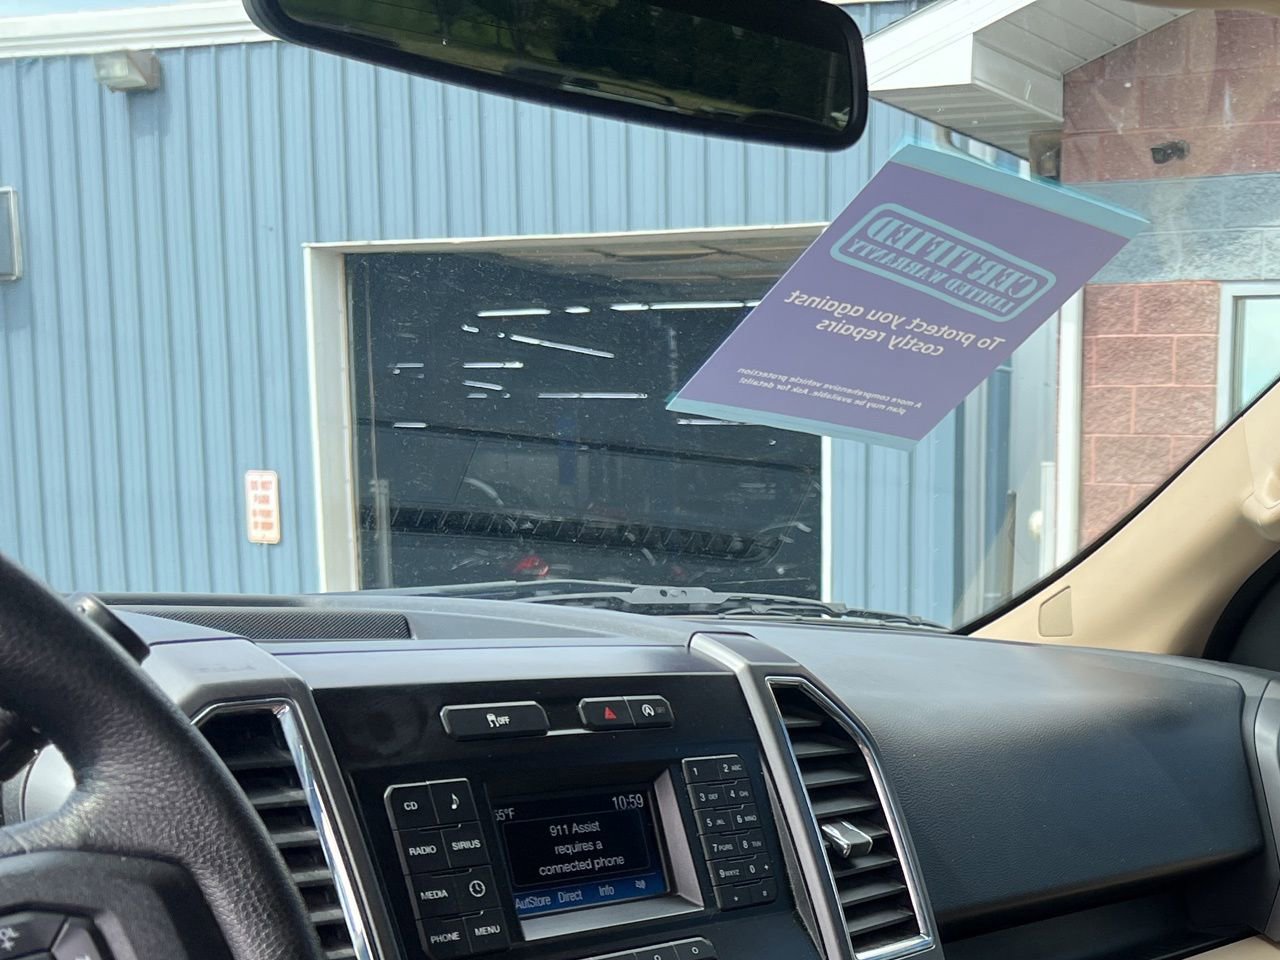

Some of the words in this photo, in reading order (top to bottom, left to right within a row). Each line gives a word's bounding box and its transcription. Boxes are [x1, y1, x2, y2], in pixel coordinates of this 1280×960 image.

[693, 767, 698, 776] 1
[722, 763, 729, 773] 2
[700, 792, 706, 802] 3
[730, 789, 736, 798] 4
[404, 801, 418, 811] CD
[612, 793, 644, 811] 10:59
[706, 818, 713, 827] 5
[736, 814, 743, 824] 6
[550, 824, 568, 837] 911
[572, 821, 600, 835] Assist
[451, 839, 481, 851] SIRIUS
[554, 841, 594, 856] requires
[596, 841, 603, 849] a
[712, 843, 718, 853] 7
[742, 840, 749, 849] 8
[408, 845, 437, 856] RADIO
[538, 859, 593, 876] connected
[594, 855, 625, 871] phone
[749, 864, 756, 874] 0
[719, 869, 726, 878] 9
[420, 889, 449, 900] MEDIA
[599, 885, 615, 896] Info
[515, 894, 552, 909] AutStore
[557, 890, 583, 903] Direct
[474, 925, 501, 936] MENU
[430, 931, 461, 944] PHONE
